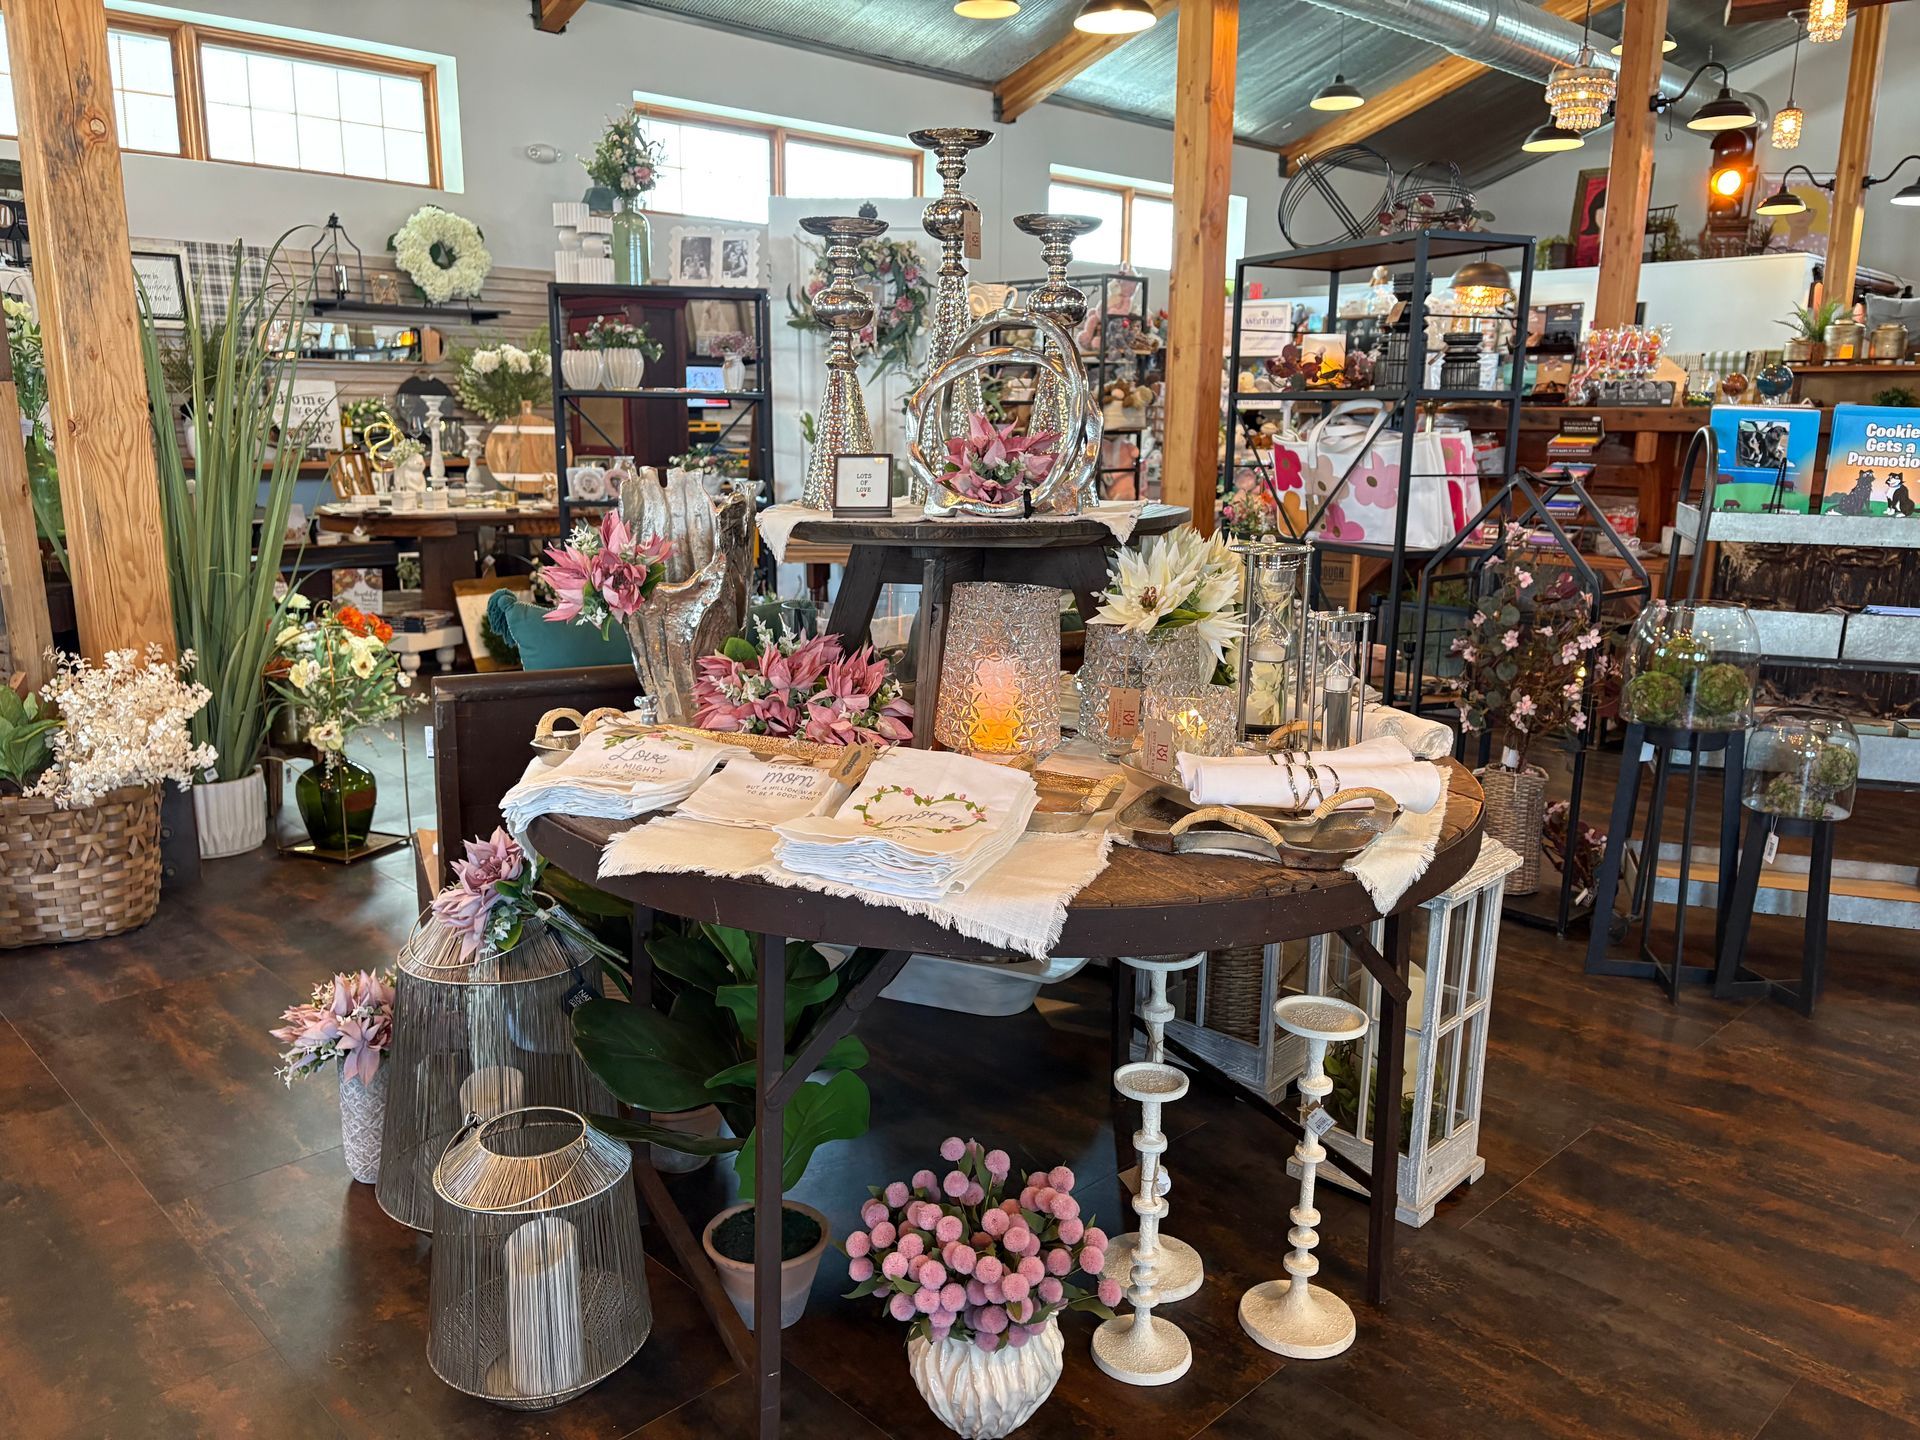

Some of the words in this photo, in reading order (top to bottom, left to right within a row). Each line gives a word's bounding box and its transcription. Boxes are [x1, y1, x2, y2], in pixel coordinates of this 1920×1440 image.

[1866, 423, 1920, 439] Cookie
[1866, 438, 1903, 453] Gets
[1905, 443, 1916, 454] a
[608, 740, 670, 764] Love
[622, 762, 667, 775] MIGHTY
[762, 771, 815, 788] mom
[769, 785, 799, 794] MILLION
[800, 789, 823, 797] WAYS
[776, 791, 798, 800] GOOD
